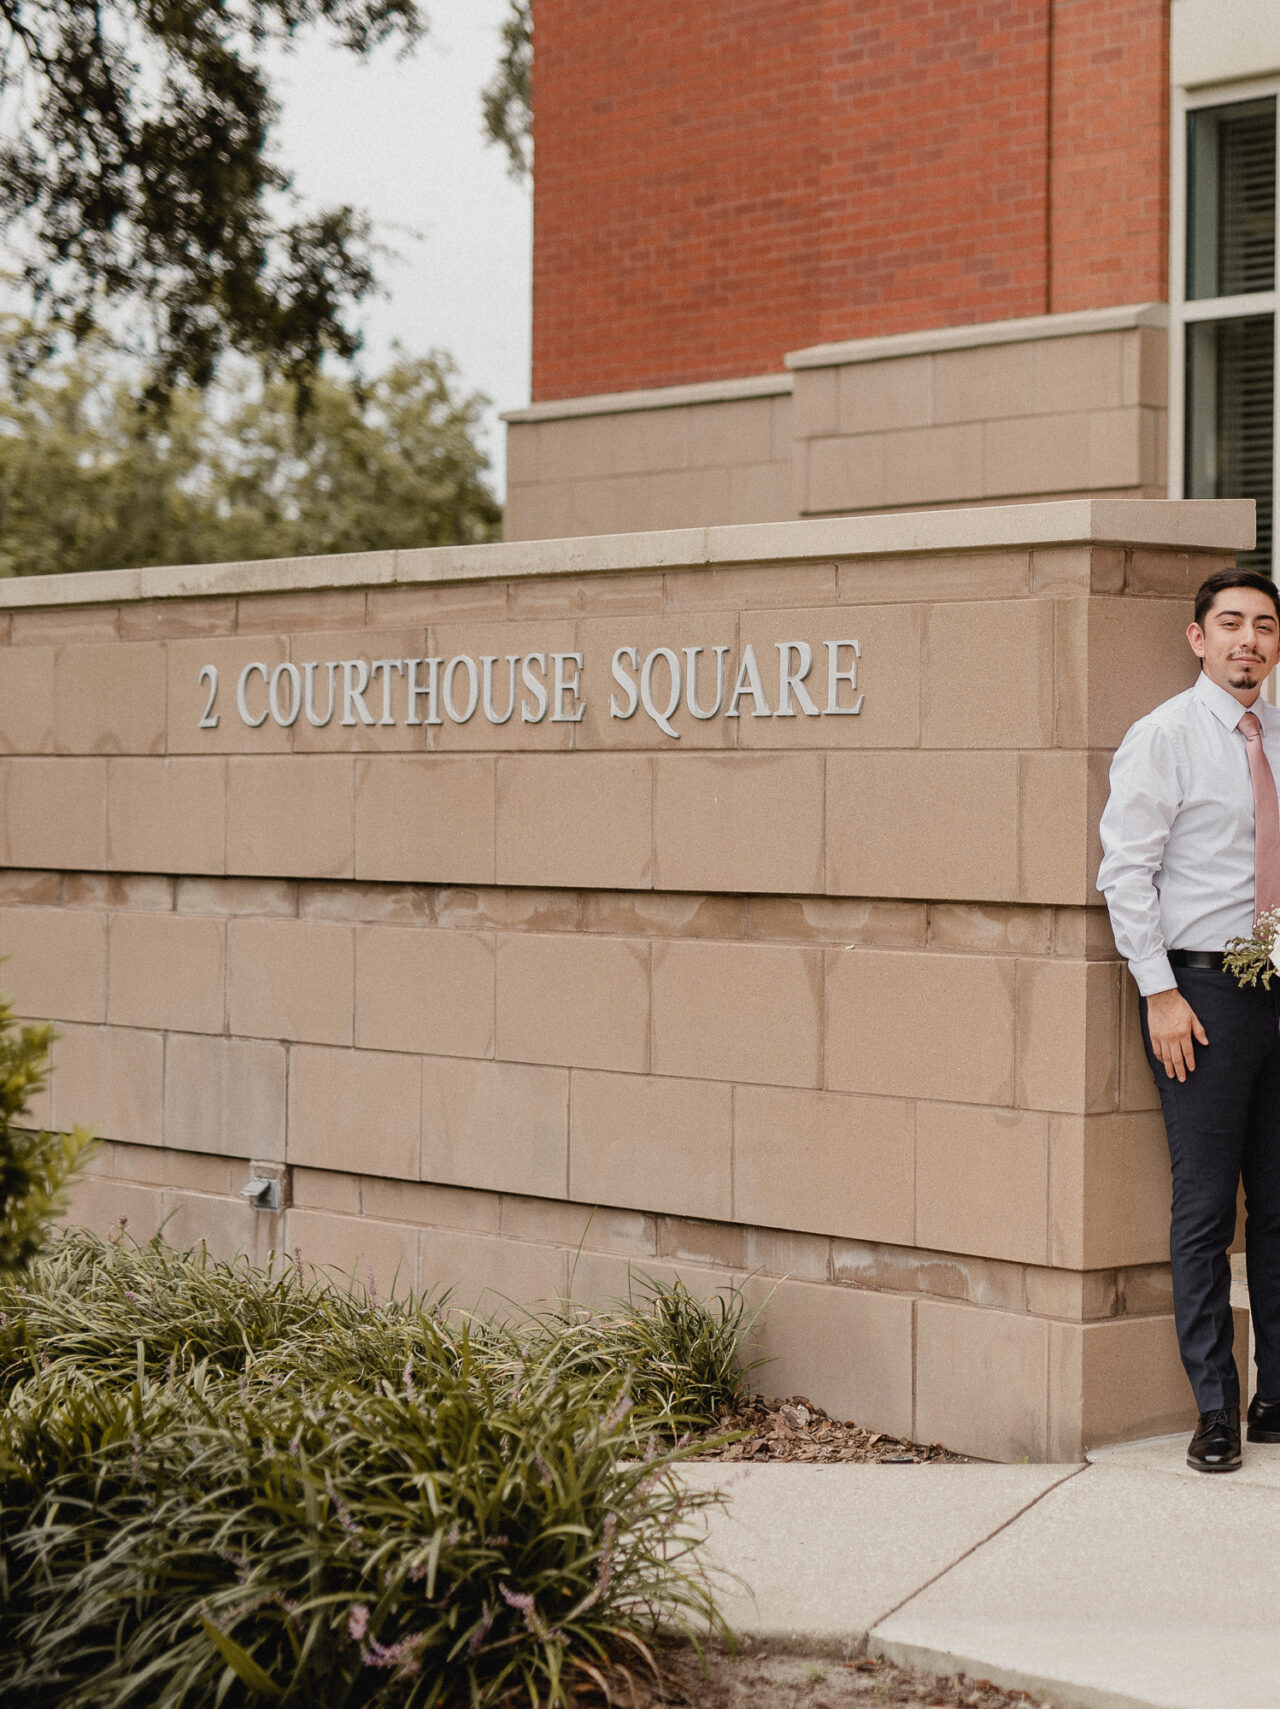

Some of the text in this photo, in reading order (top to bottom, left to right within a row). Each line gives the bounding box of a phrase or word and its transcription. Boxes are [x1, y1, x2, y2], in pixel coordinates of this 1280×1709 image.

[197, 639, 866, 739] 2 COURTHOUSE SQUARE
